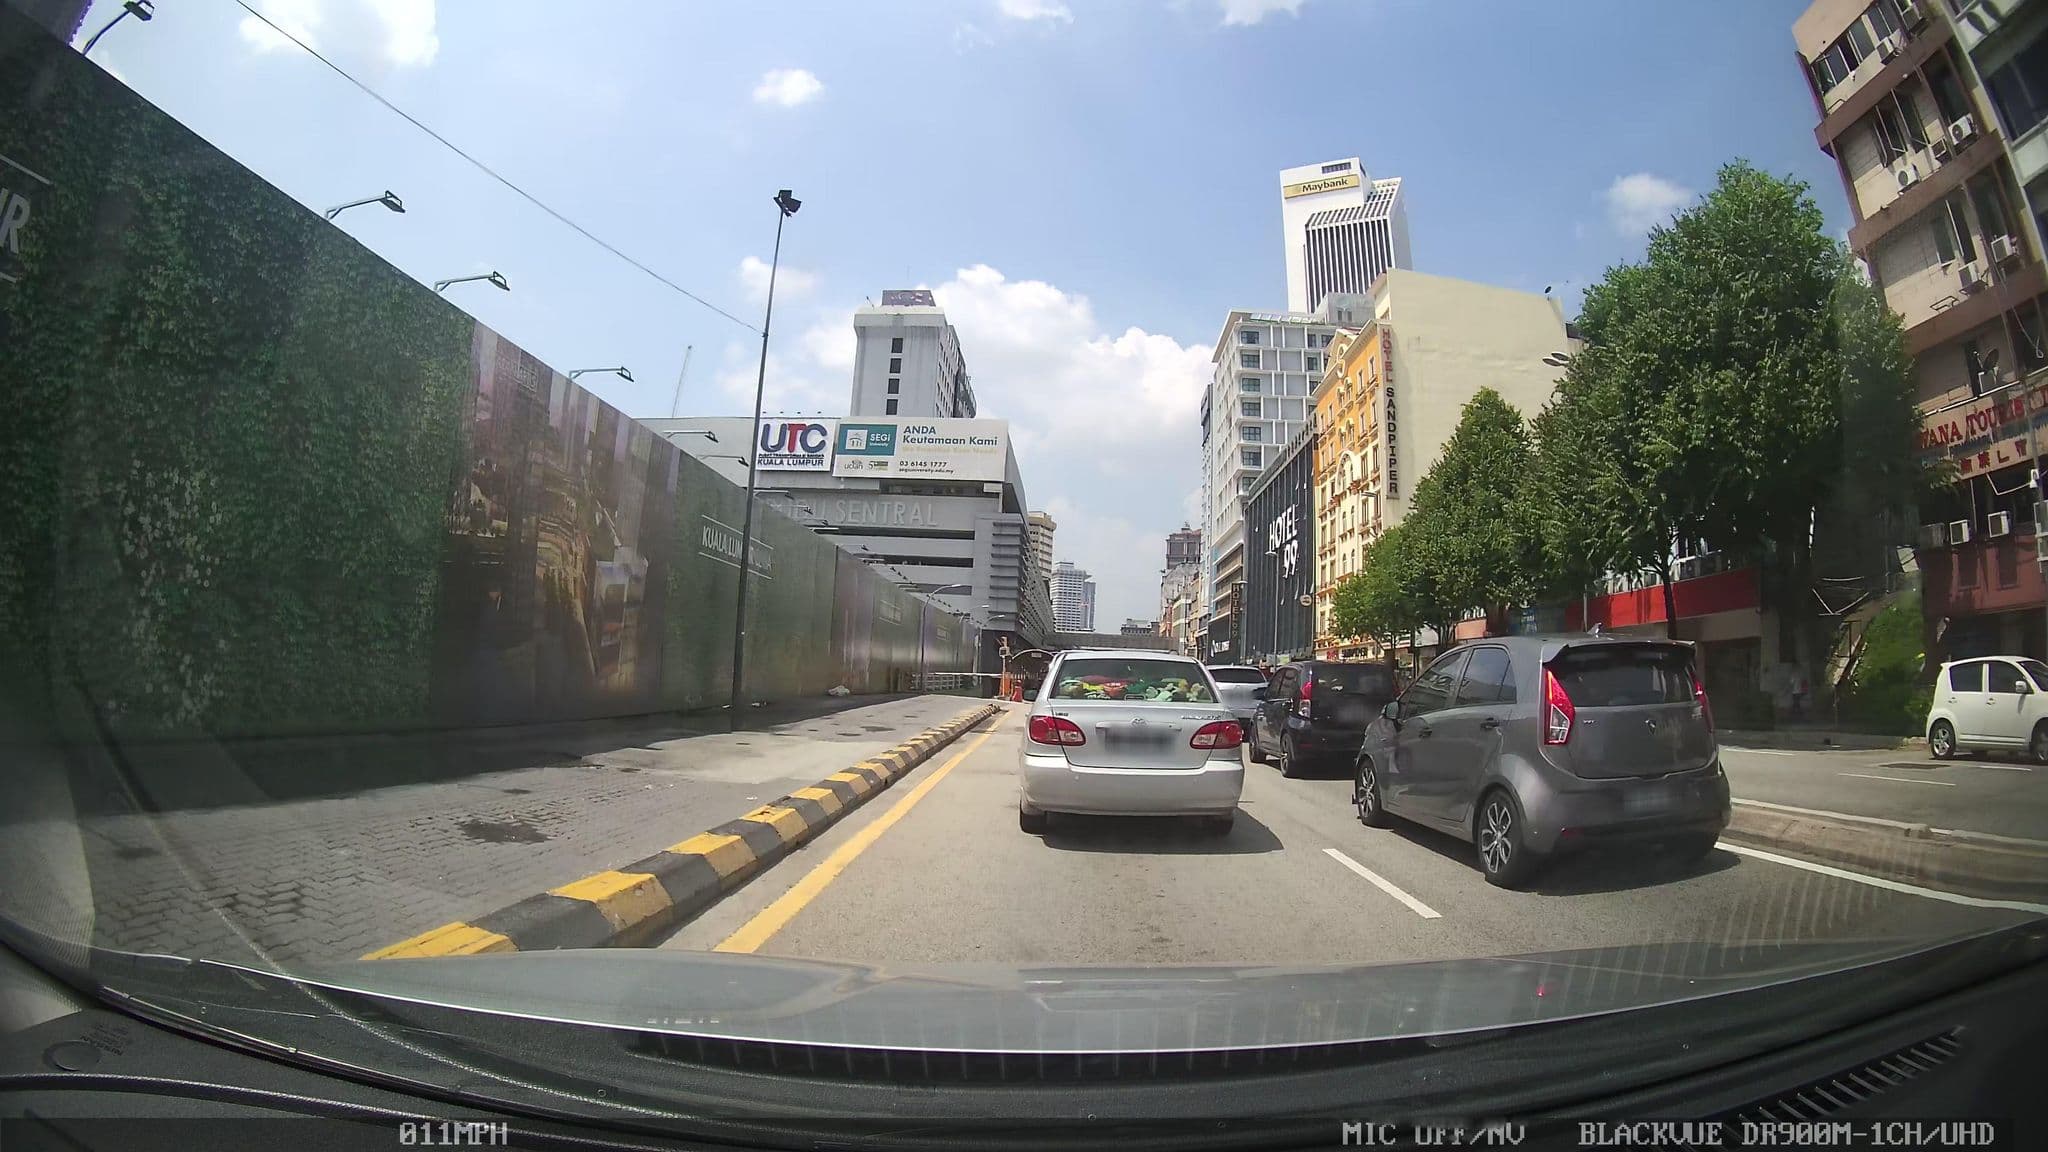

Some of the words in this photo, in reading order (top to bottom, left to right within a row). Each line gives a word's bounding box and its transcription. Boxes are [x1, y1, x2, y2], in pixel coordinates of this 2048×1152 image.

[1302, 178, 1349, 192] Maybank
[1382, 329, 1393, 383] HOTEL
[760, 423, 828, 453] UTC
[902, 435, 966, 445] Keutamaan
[969, 436, 998, 446] Kami
[903, 425, 937, 435] ANDA
[1386, 386, 1398, 494] SANDPIPER
[787, 459, 825, 467] LUMPUR
[836, 500, 939, 527] SENTRAL
[1269, 503, 1298, 552] HOTEL
[702, 526, 727, 554] KUALA
[1283, 539, 1299, 579] 99
[1232, 584, 1240, 620] HOTEL
